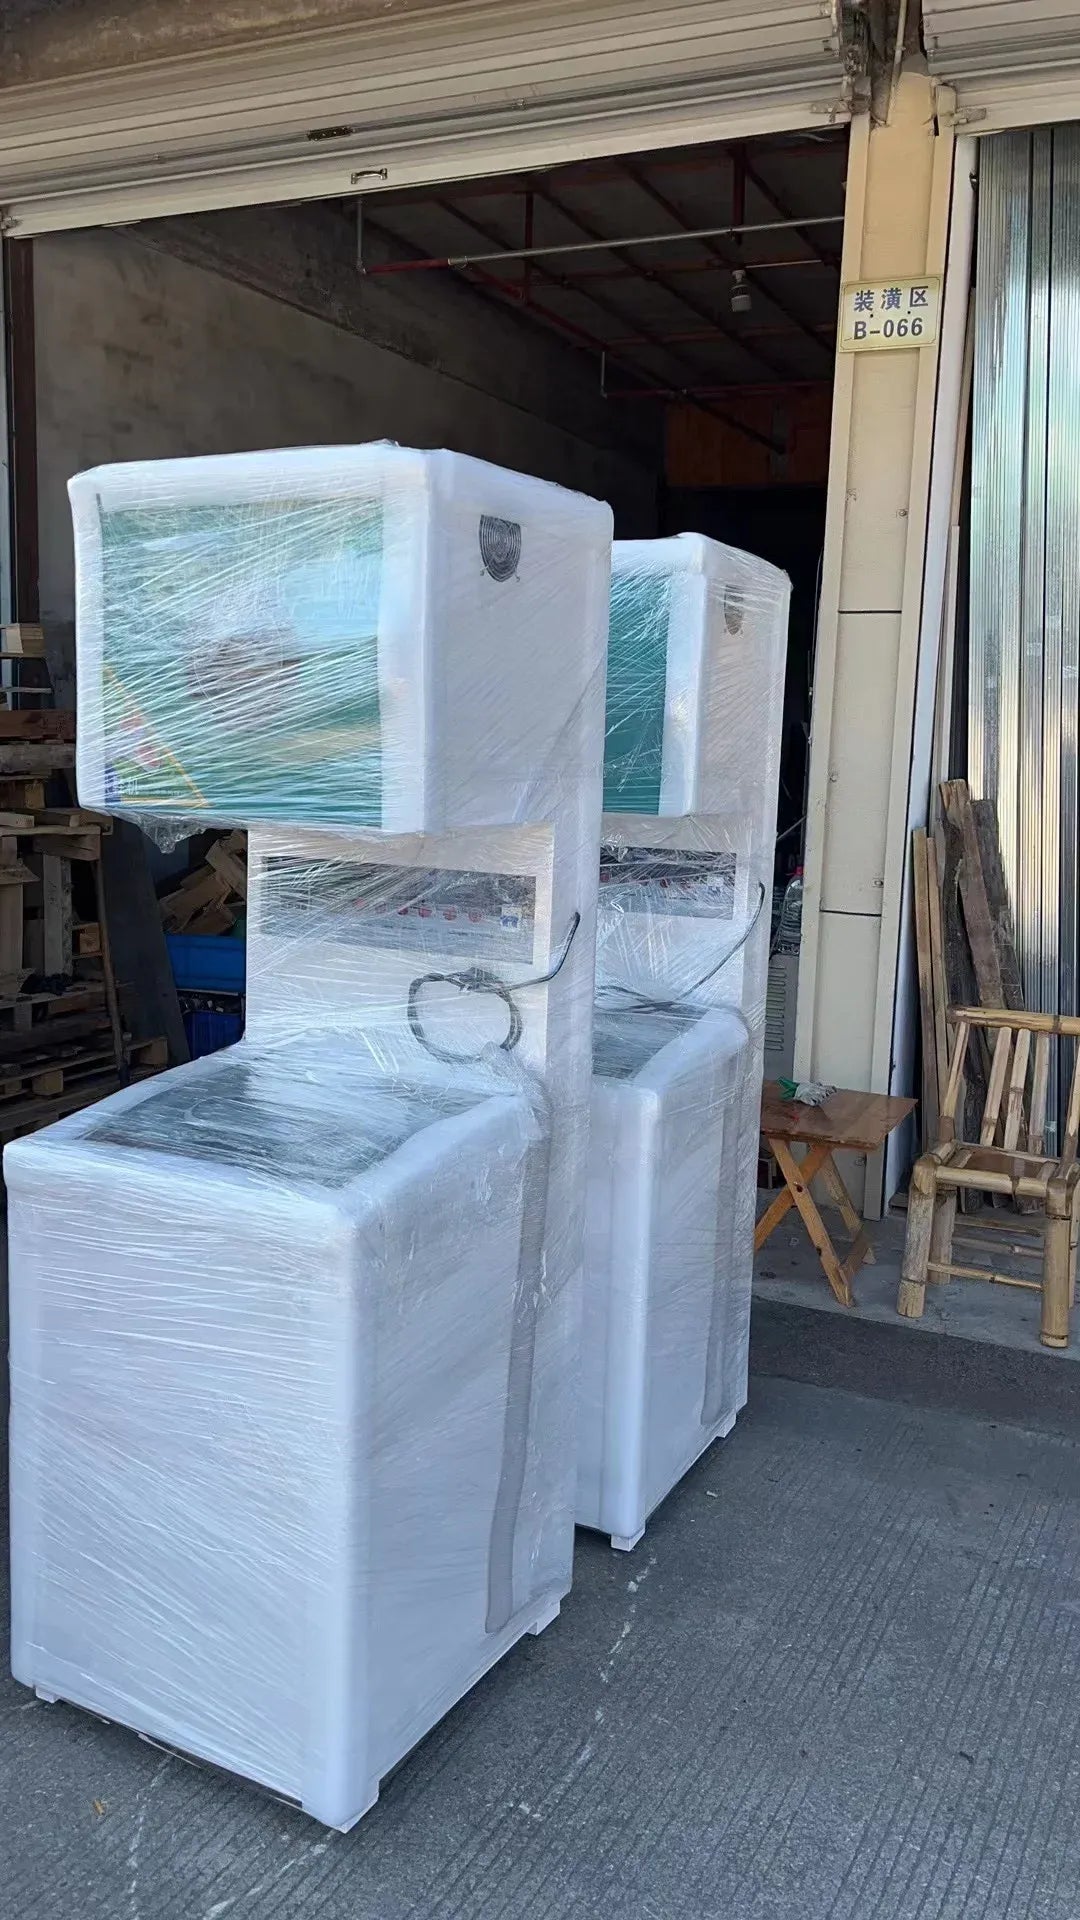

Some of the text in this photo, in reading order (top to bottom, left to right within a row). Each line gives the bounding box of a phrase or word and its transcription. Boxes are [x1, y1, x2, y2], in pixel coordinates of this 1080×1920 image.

[854, 286, 928, 312] 装潢区
[854, 317, 923, 340] B-066
